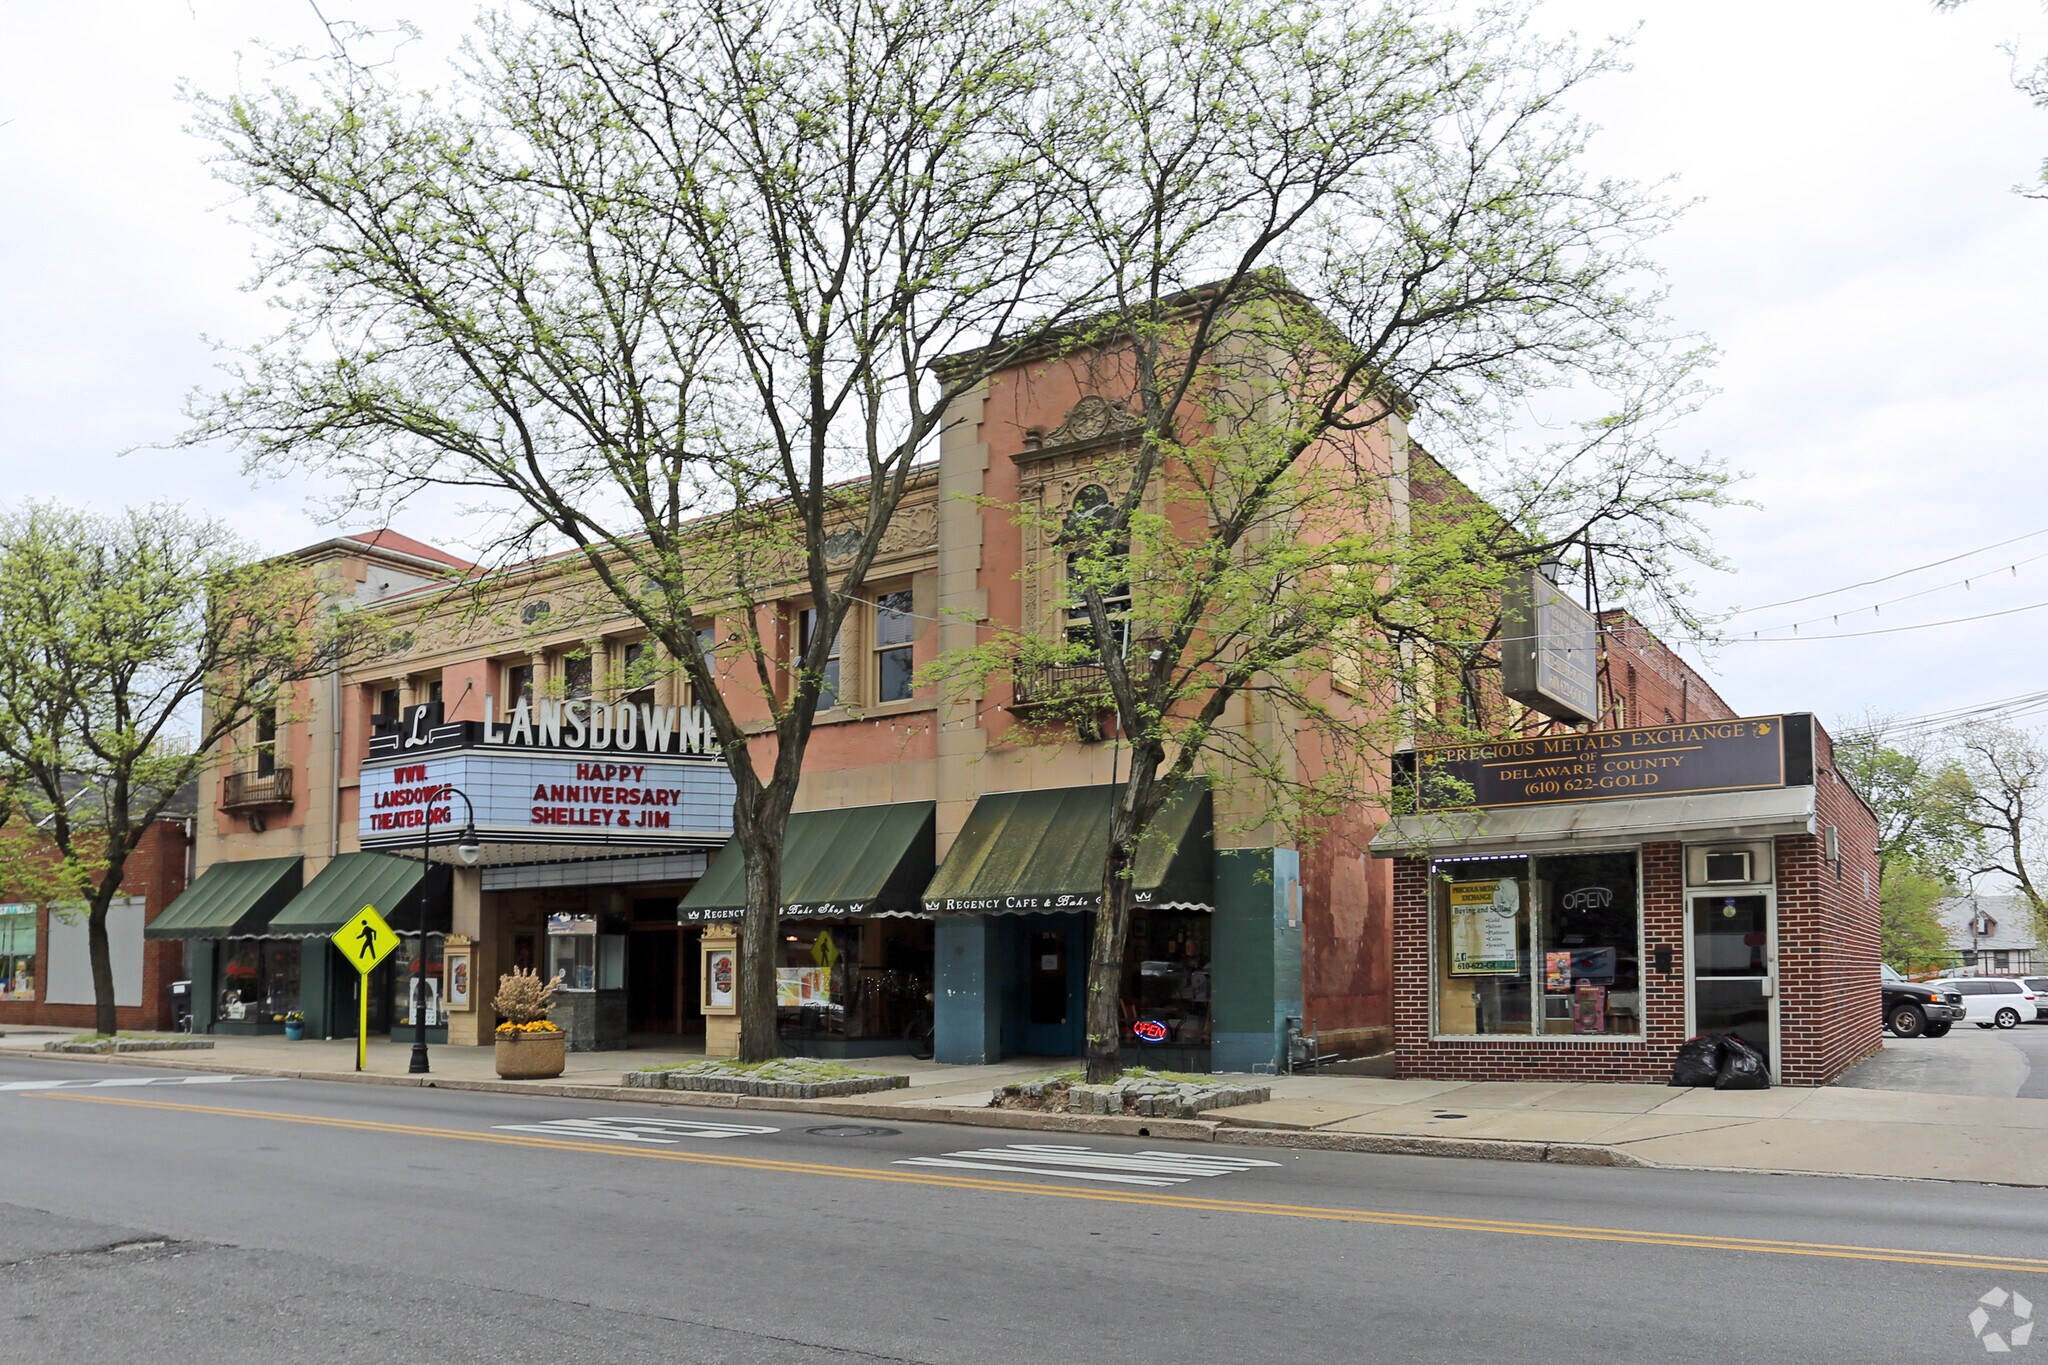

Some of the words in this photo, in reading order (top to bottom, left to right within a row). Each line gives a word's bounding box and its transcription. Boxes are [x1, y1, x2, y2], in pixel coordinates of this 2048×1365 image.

[405, 705, 427, 748] L
[1447, 743, 1535, 762] PRECIOUS
[1544, 735, 1622, 753] METALS
[1632, 723, 1745, 746] EXCHANGE
[1580, 752, 1597, 762] OF
[576, 763, 645, 783] HAPPY
[1500, 764, 1597, 781] DELAWARE
[1604, 756, 1684, 772] COUNTY
[1525, 781, 1560, 796] (610)
[1564, 773, 1659, 791] 622-GOLD
[374, 783, 452, 809] LANSDOWNE
[533, 784, 681, 806] ANNIVERSARY
[531, 807, 613, 827] SHELLEY
[617, 809, 630, 827] &
[635, 810, 670, 828] JIM
[946, 899, 1000, 910] REGENCY
[1006, 896, 1038, 908] CAFE
[1043, 899, 1051, 907] &
[1055, 894, 1088, 907] Bake
[1454, 907, 1476, 916] Buying
[1477, 905, 1489, 913] and
[1563, 892, 1610, 910] OPEN
[703, 908, 745, 920] REGENCY
[787, 904, 813, 915] Bake
[817, 903, 845, 915] Shop
[1457, 961, 1512, 970] 610-622-GO
[1134, 1021, 1166, 1037] OPEN
